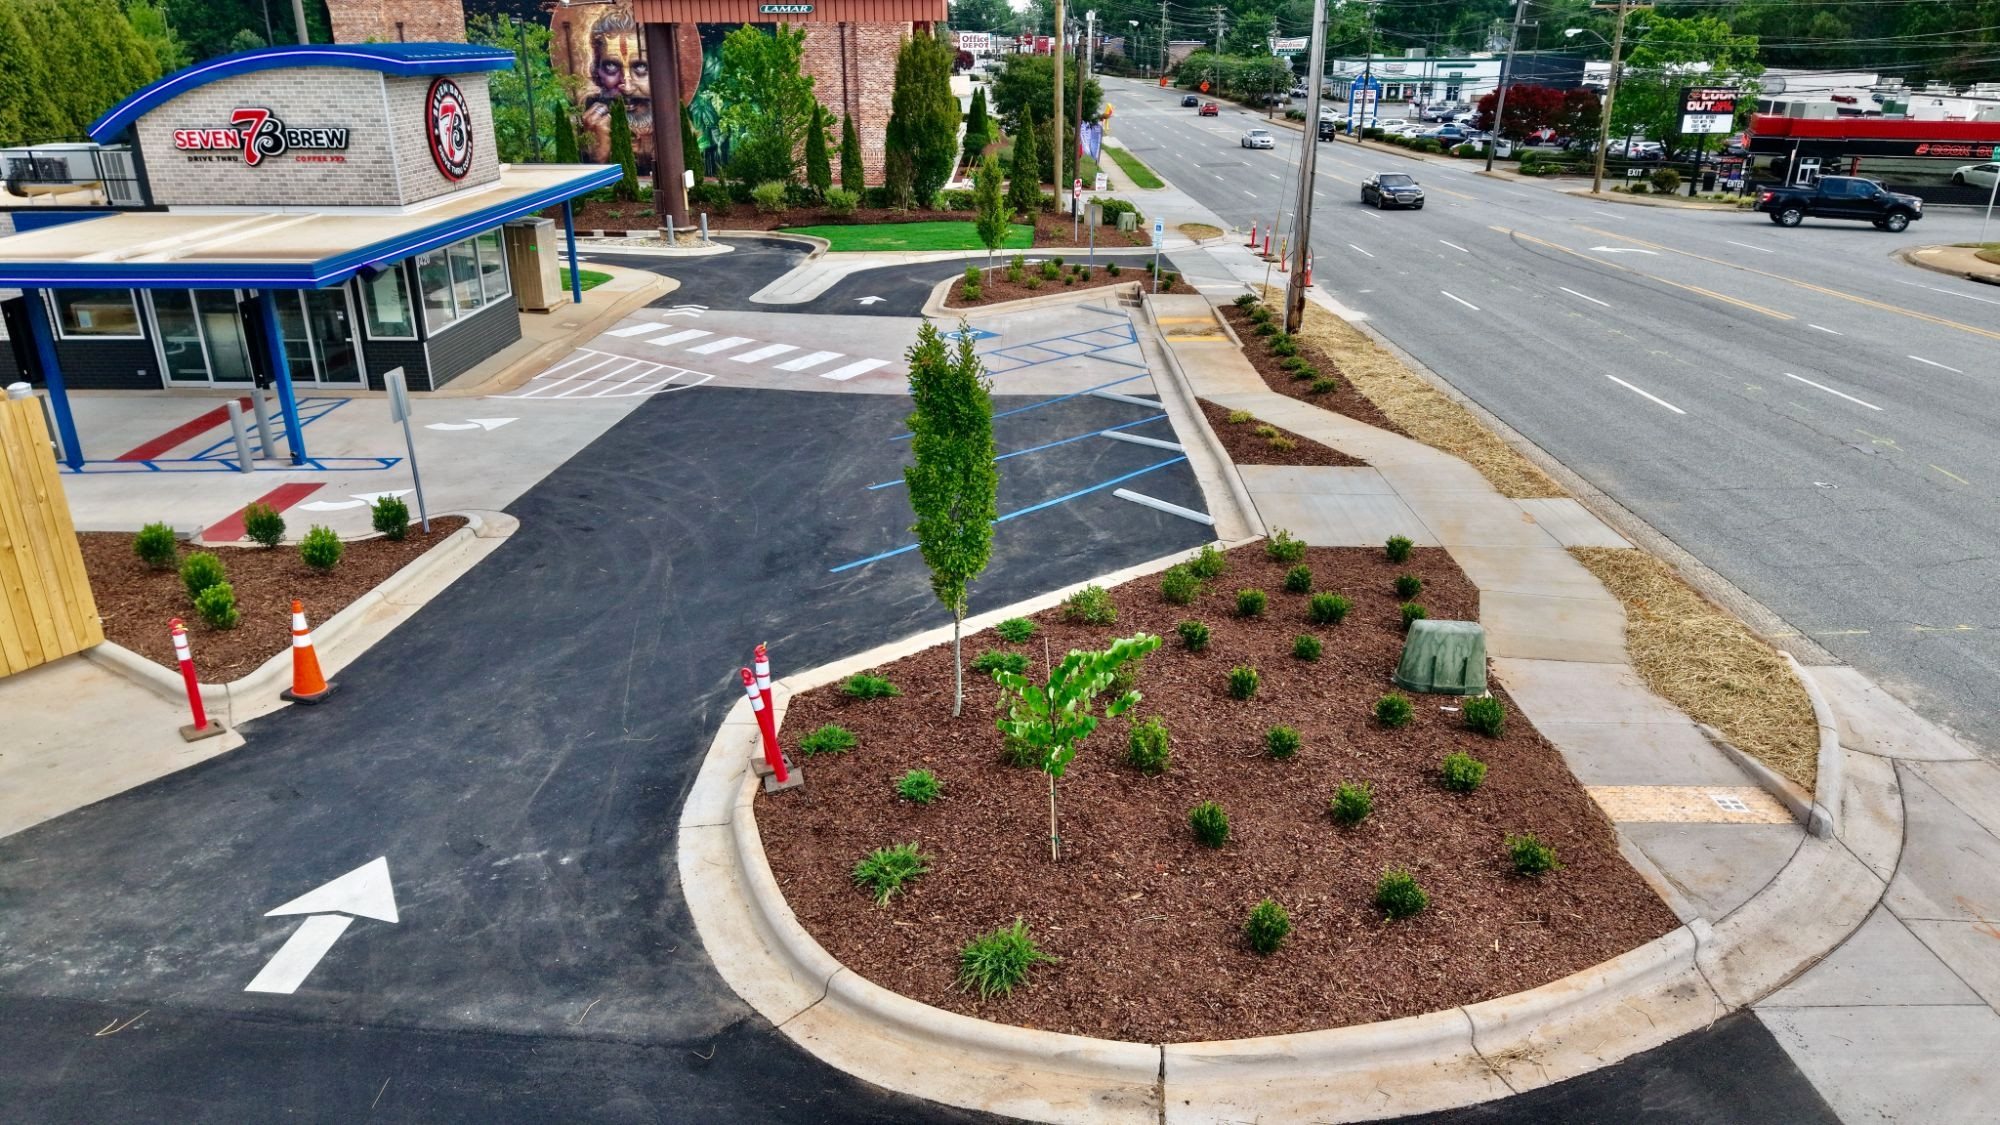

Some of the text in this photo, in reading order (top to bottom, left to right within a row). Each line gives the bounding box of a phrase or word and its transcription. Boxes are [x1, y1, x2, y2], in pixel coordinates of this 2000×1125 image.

[764, 5, 808, 13] LAMAR
[962, 35, 989, 43] Office
[1701, 89, 1737, 100] COOK
[433, 83, 468, 117] SEVEN BREW
[1687, 101, 1715, 111] OUT
[174, 129, 241, 149] SEVEN
[286, 129, 347, 149] BREW
[1931, 144, 1970, 156] COOK
[1976, 145, 1993, 157] OU
[1627, 168, 1644, 177] EXIT
[1726, 179, 1745, 189] ENTER
